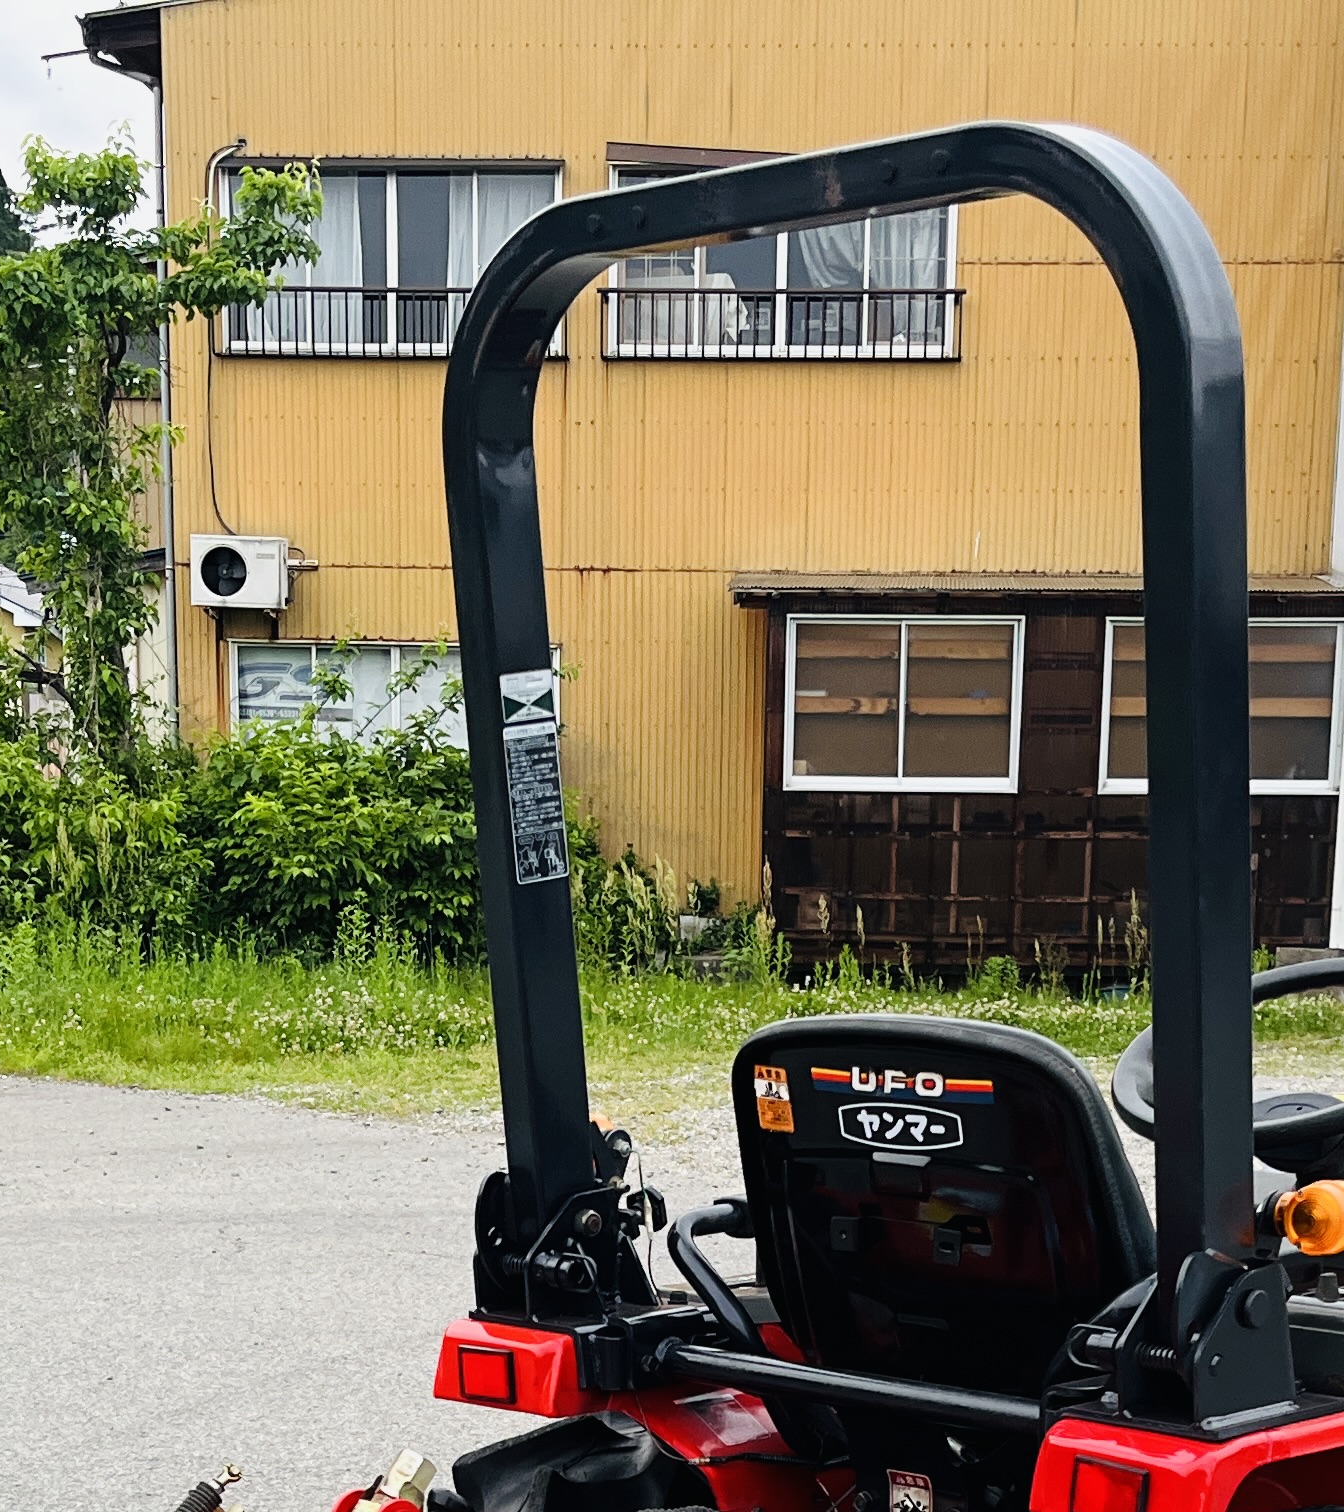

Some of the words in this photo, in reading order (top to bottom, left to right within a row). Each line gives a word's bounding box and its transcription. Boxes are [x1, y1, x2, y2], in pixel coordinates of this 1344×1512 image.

[851, 1066, 944, 1098] UFO
[857, 1109, 946, 1143] ヤンマー
